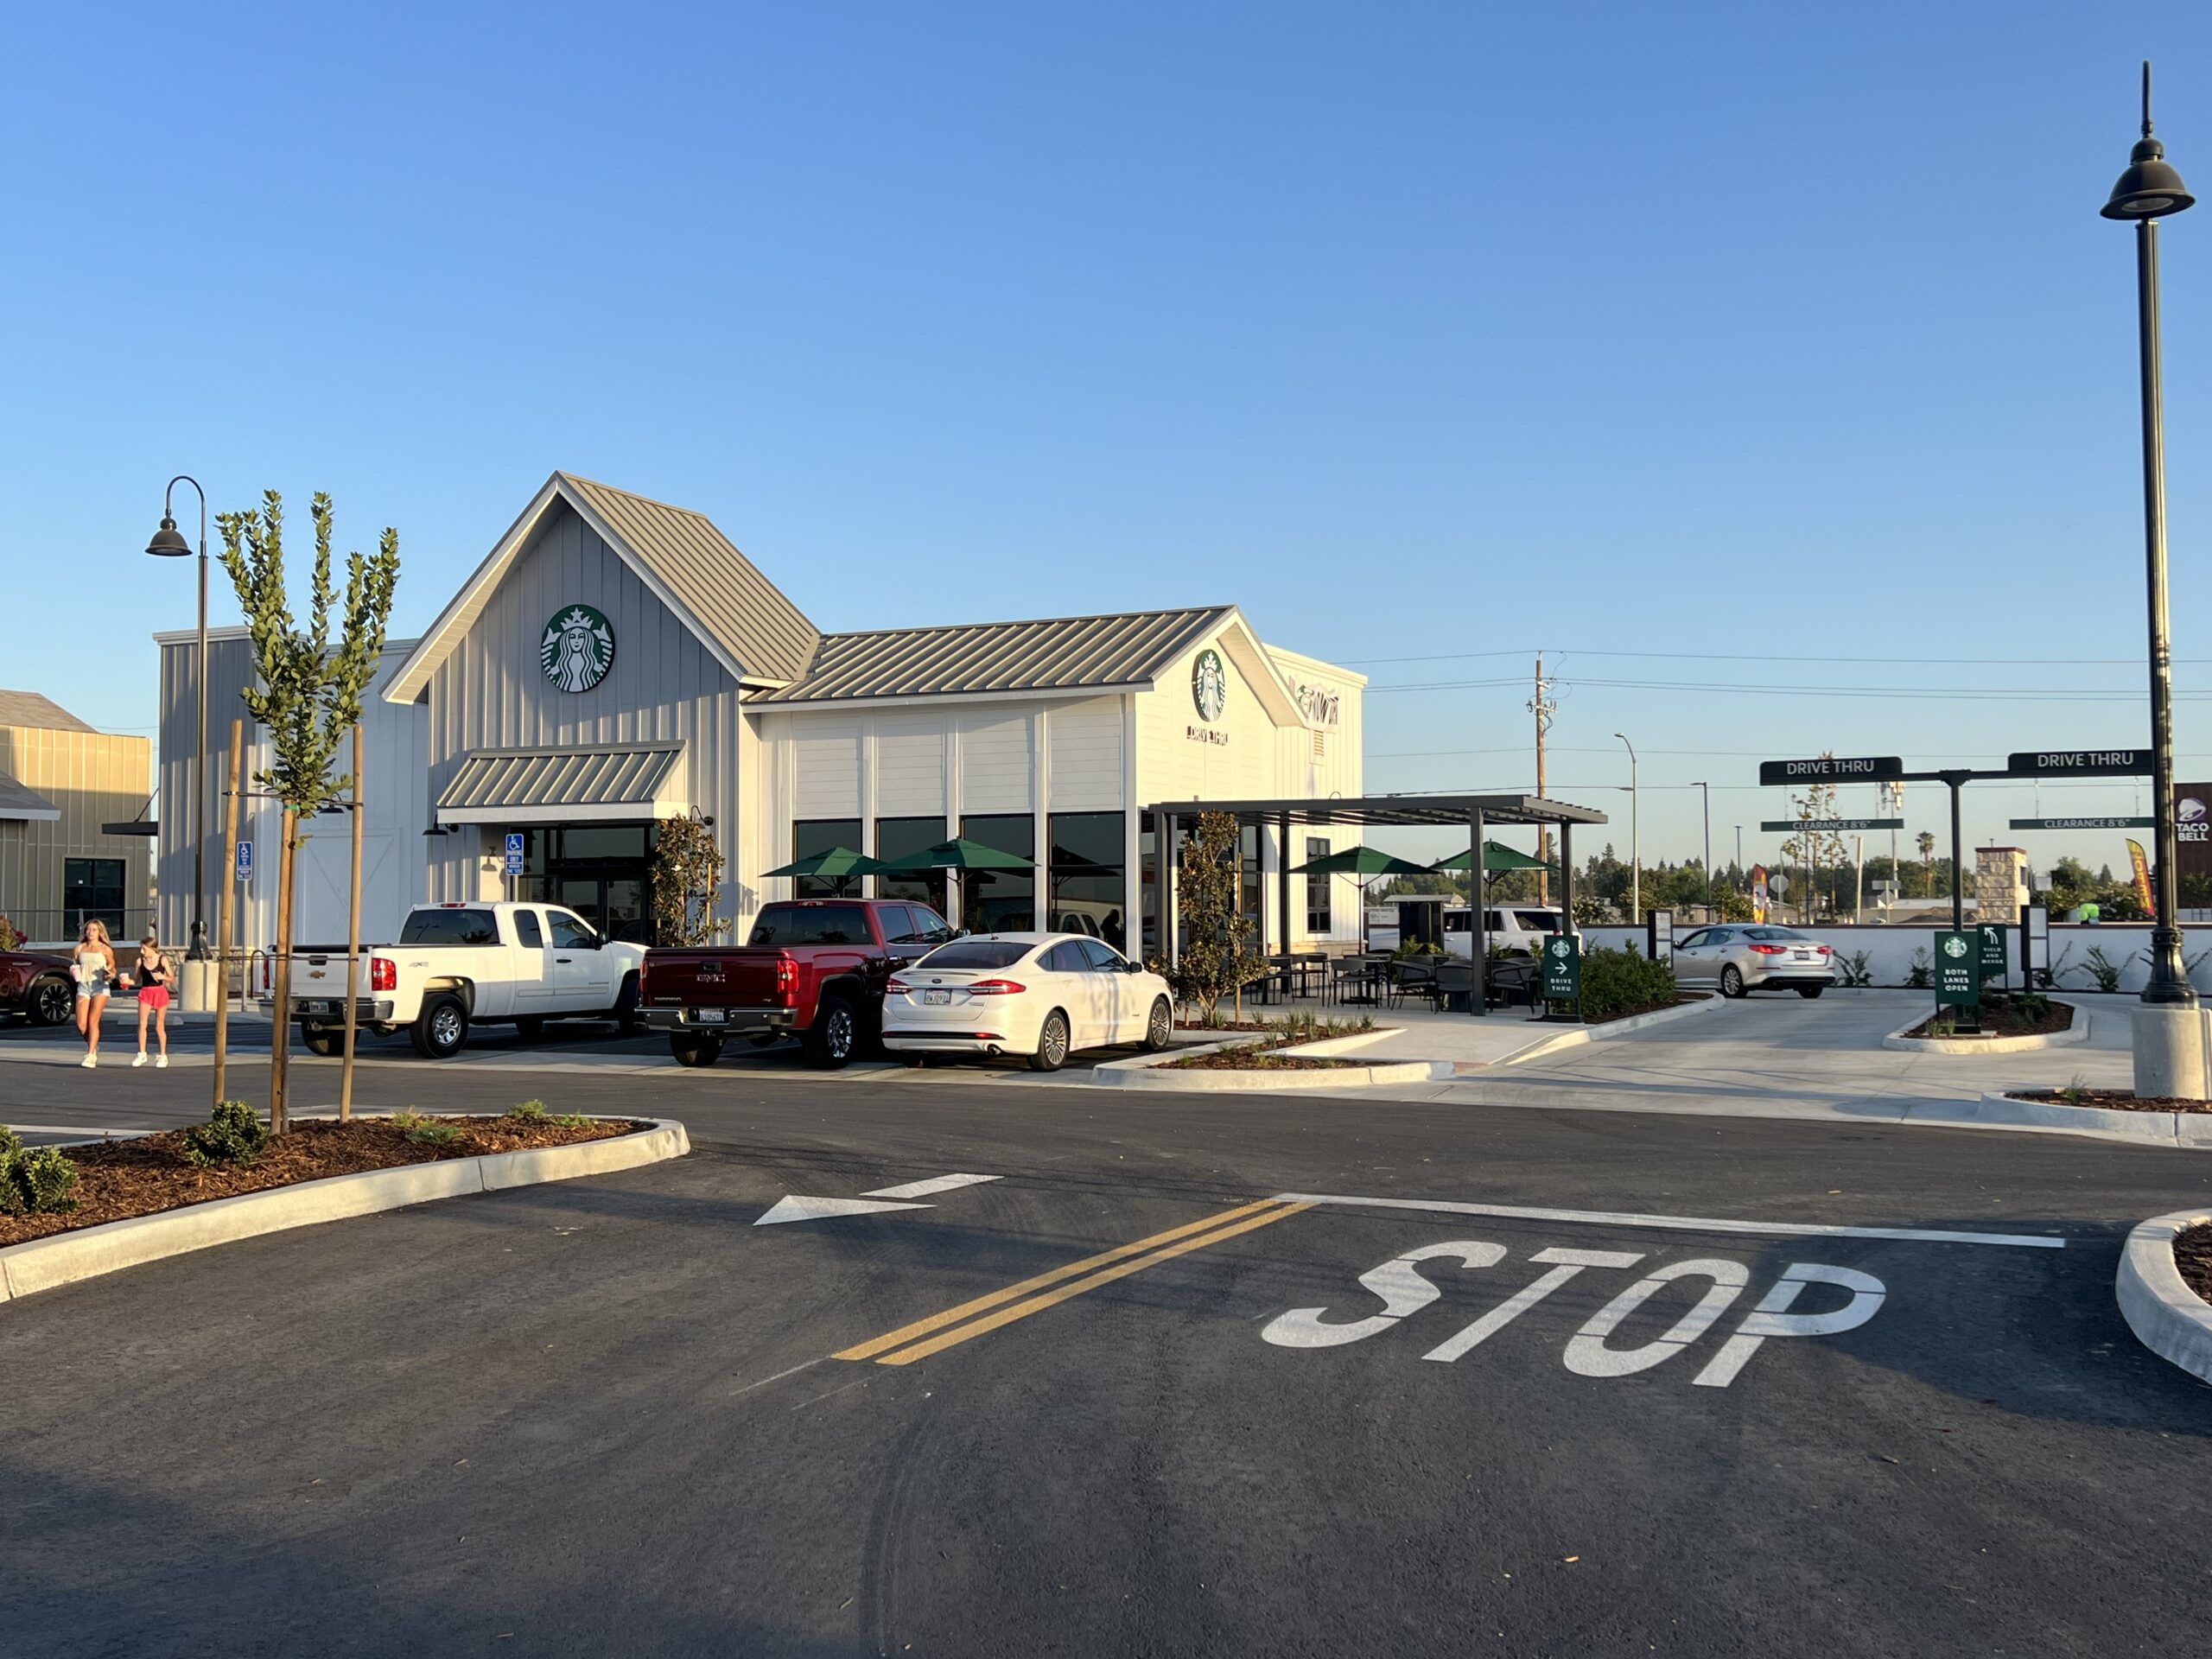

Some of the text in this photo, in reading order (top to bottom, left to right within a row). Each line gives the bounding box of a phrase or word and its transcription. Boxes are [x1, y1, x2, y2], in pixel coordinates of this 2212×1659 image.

[2037, 752, 2134, 767] DRIVE THRU
[1786, 760, 1874, 774] DRIVE THRU
[1792, 821, 1847, 830] CLEARANCE
[2044, 819, 2105, 829] CLEARANCE
[2175, 823, 2209, 832] TACO
[2177, 832, 2209, 842] BELL
[1262, 1241, 1886, 1387] STOP
